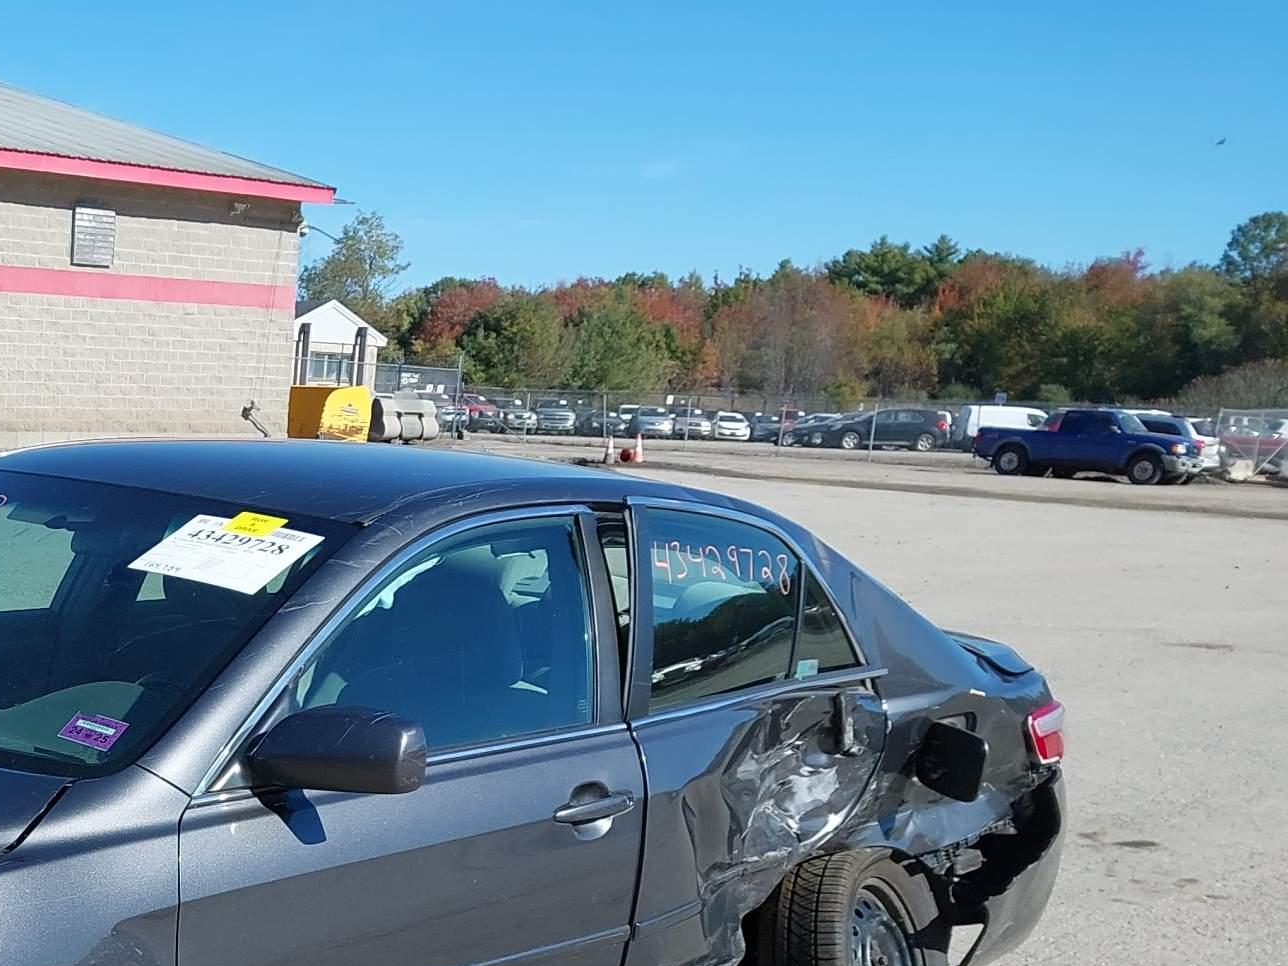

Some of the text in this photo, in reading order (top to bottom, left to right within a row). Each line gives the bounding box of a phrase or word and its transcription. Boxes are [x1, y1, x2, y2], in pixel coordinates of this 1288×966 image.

[187, 528, 290, 555] 43429728
[653, 541, 790, 596] 43429728
[68, 726, 83, 736] 24
[93, 733, 110, 744] 25
